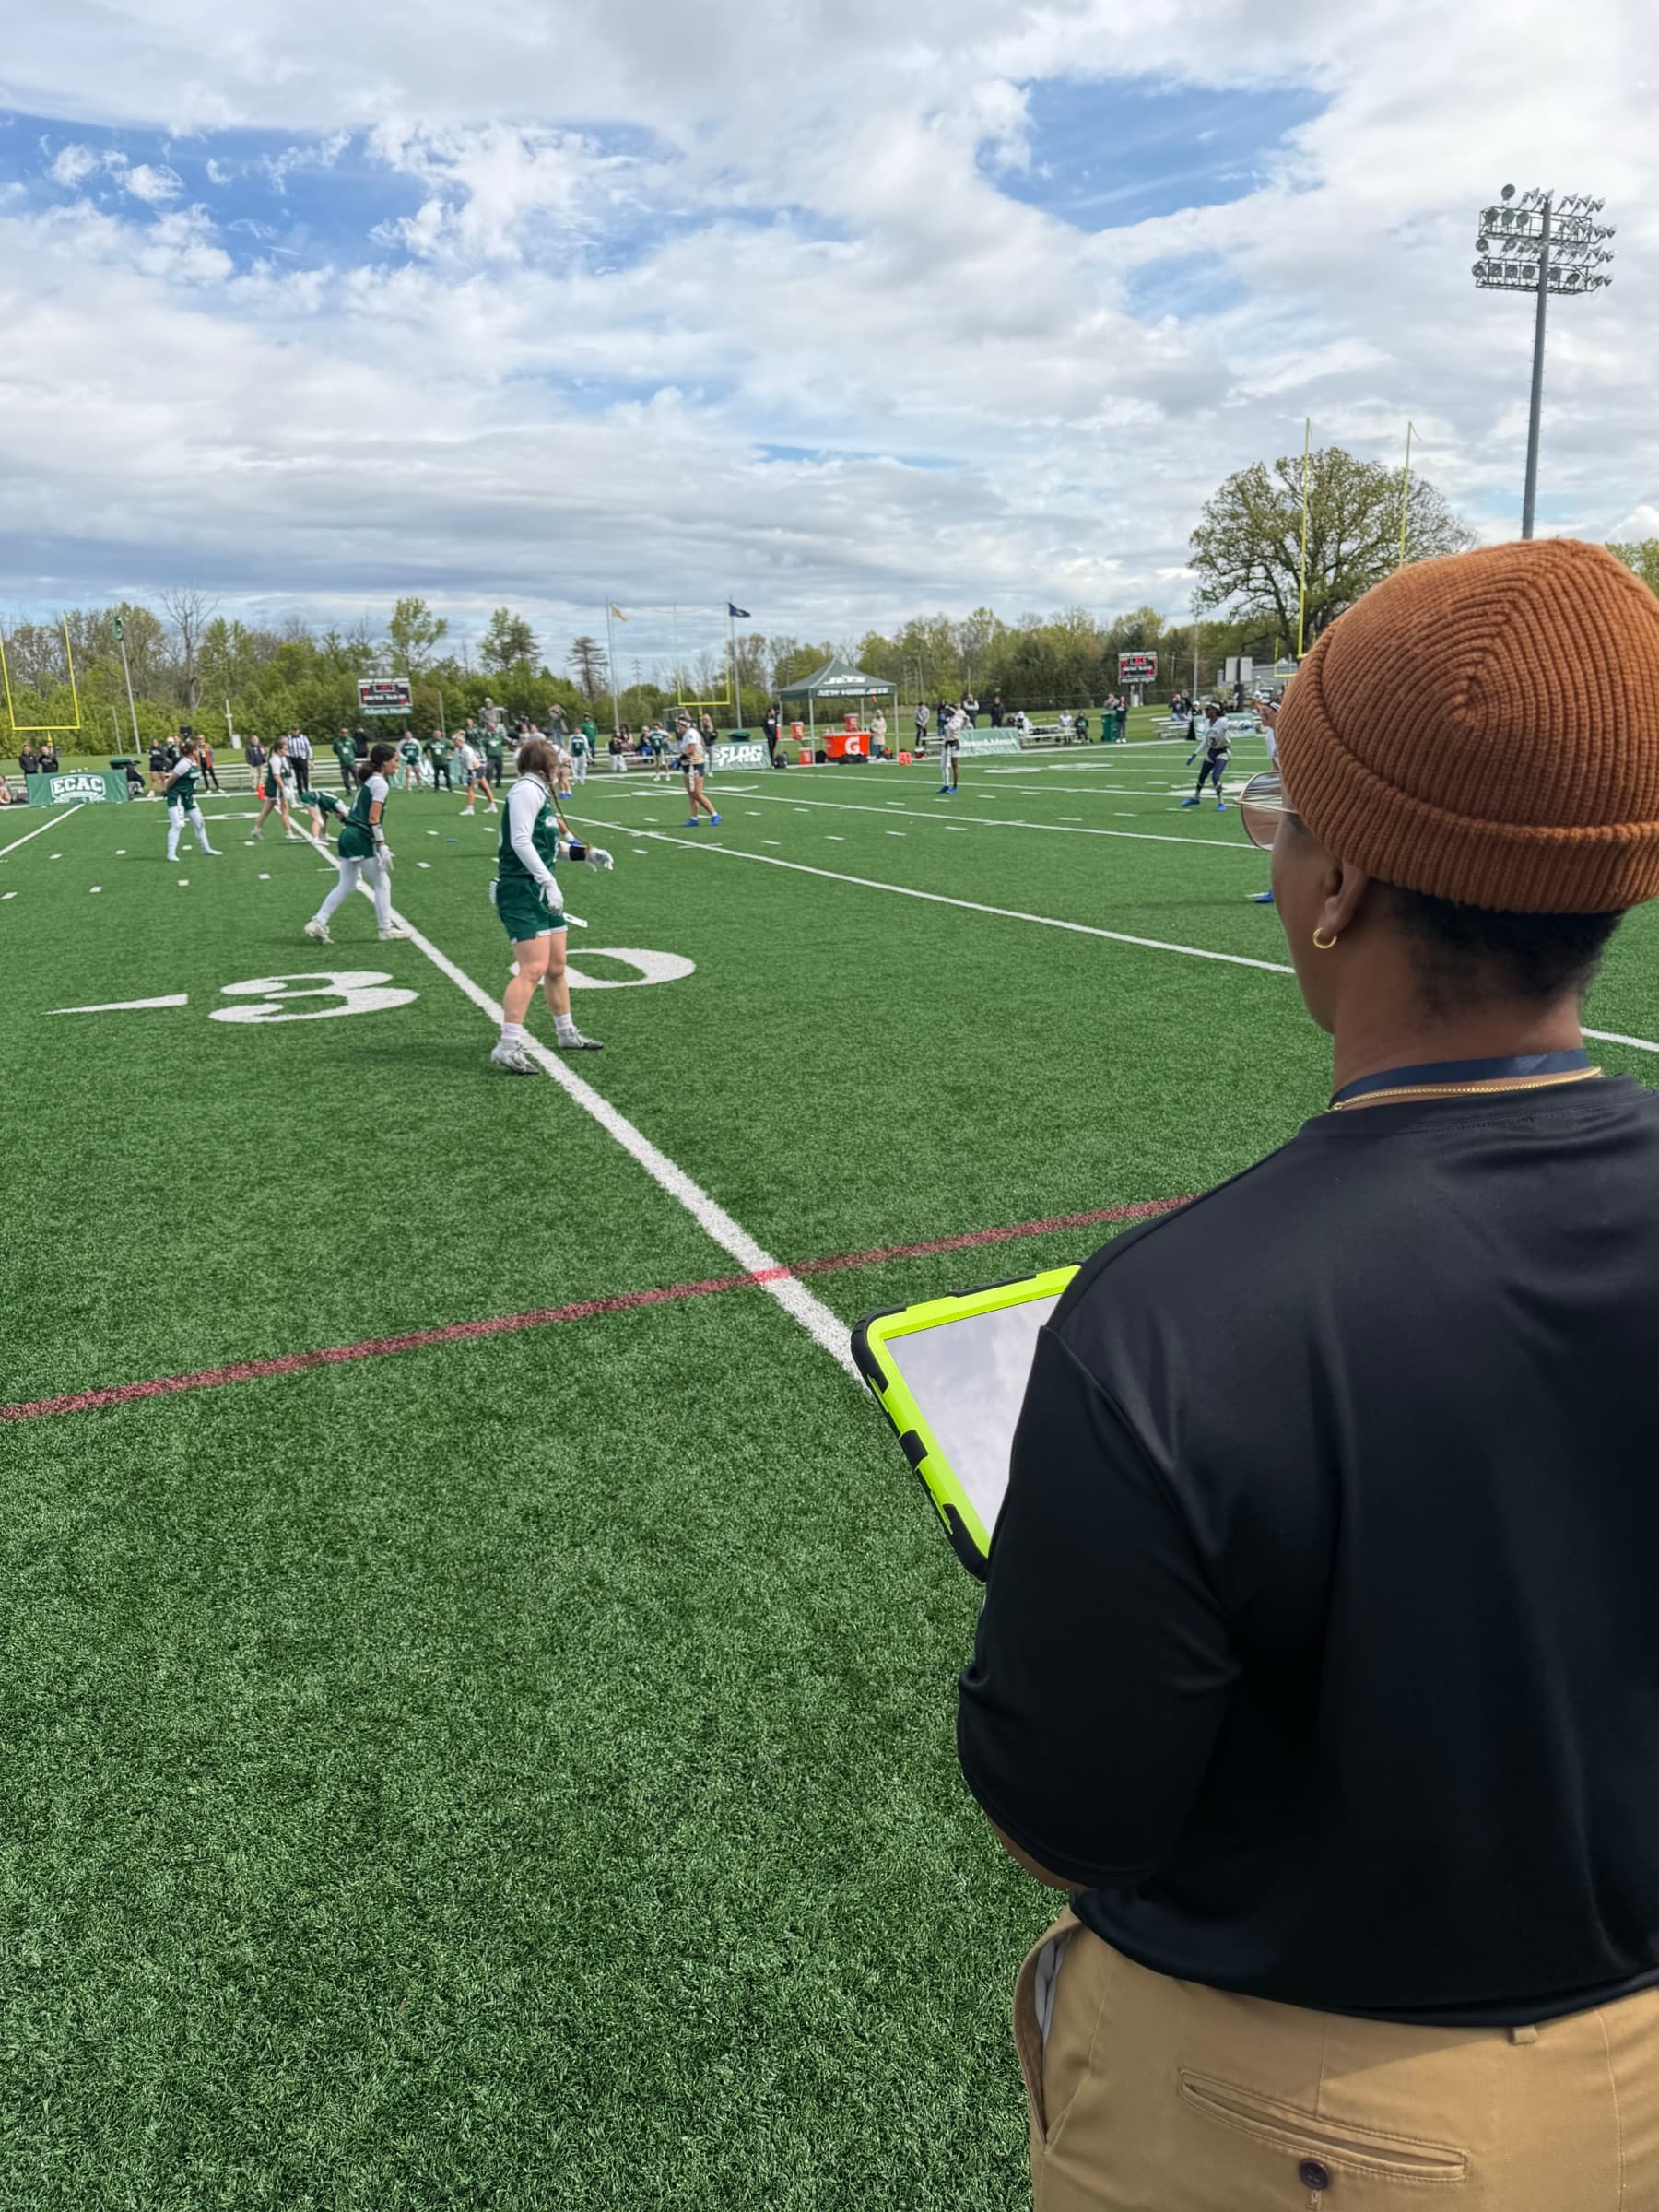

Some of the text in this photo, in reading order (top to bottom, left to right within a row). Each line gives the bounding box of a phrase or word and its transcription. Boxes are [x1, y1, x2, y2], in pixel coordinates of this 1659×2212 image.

[718, 744, 763, 767] FLAG
[844, 735, 862, 756] G
[53, 777, 103, 794] ECAC
